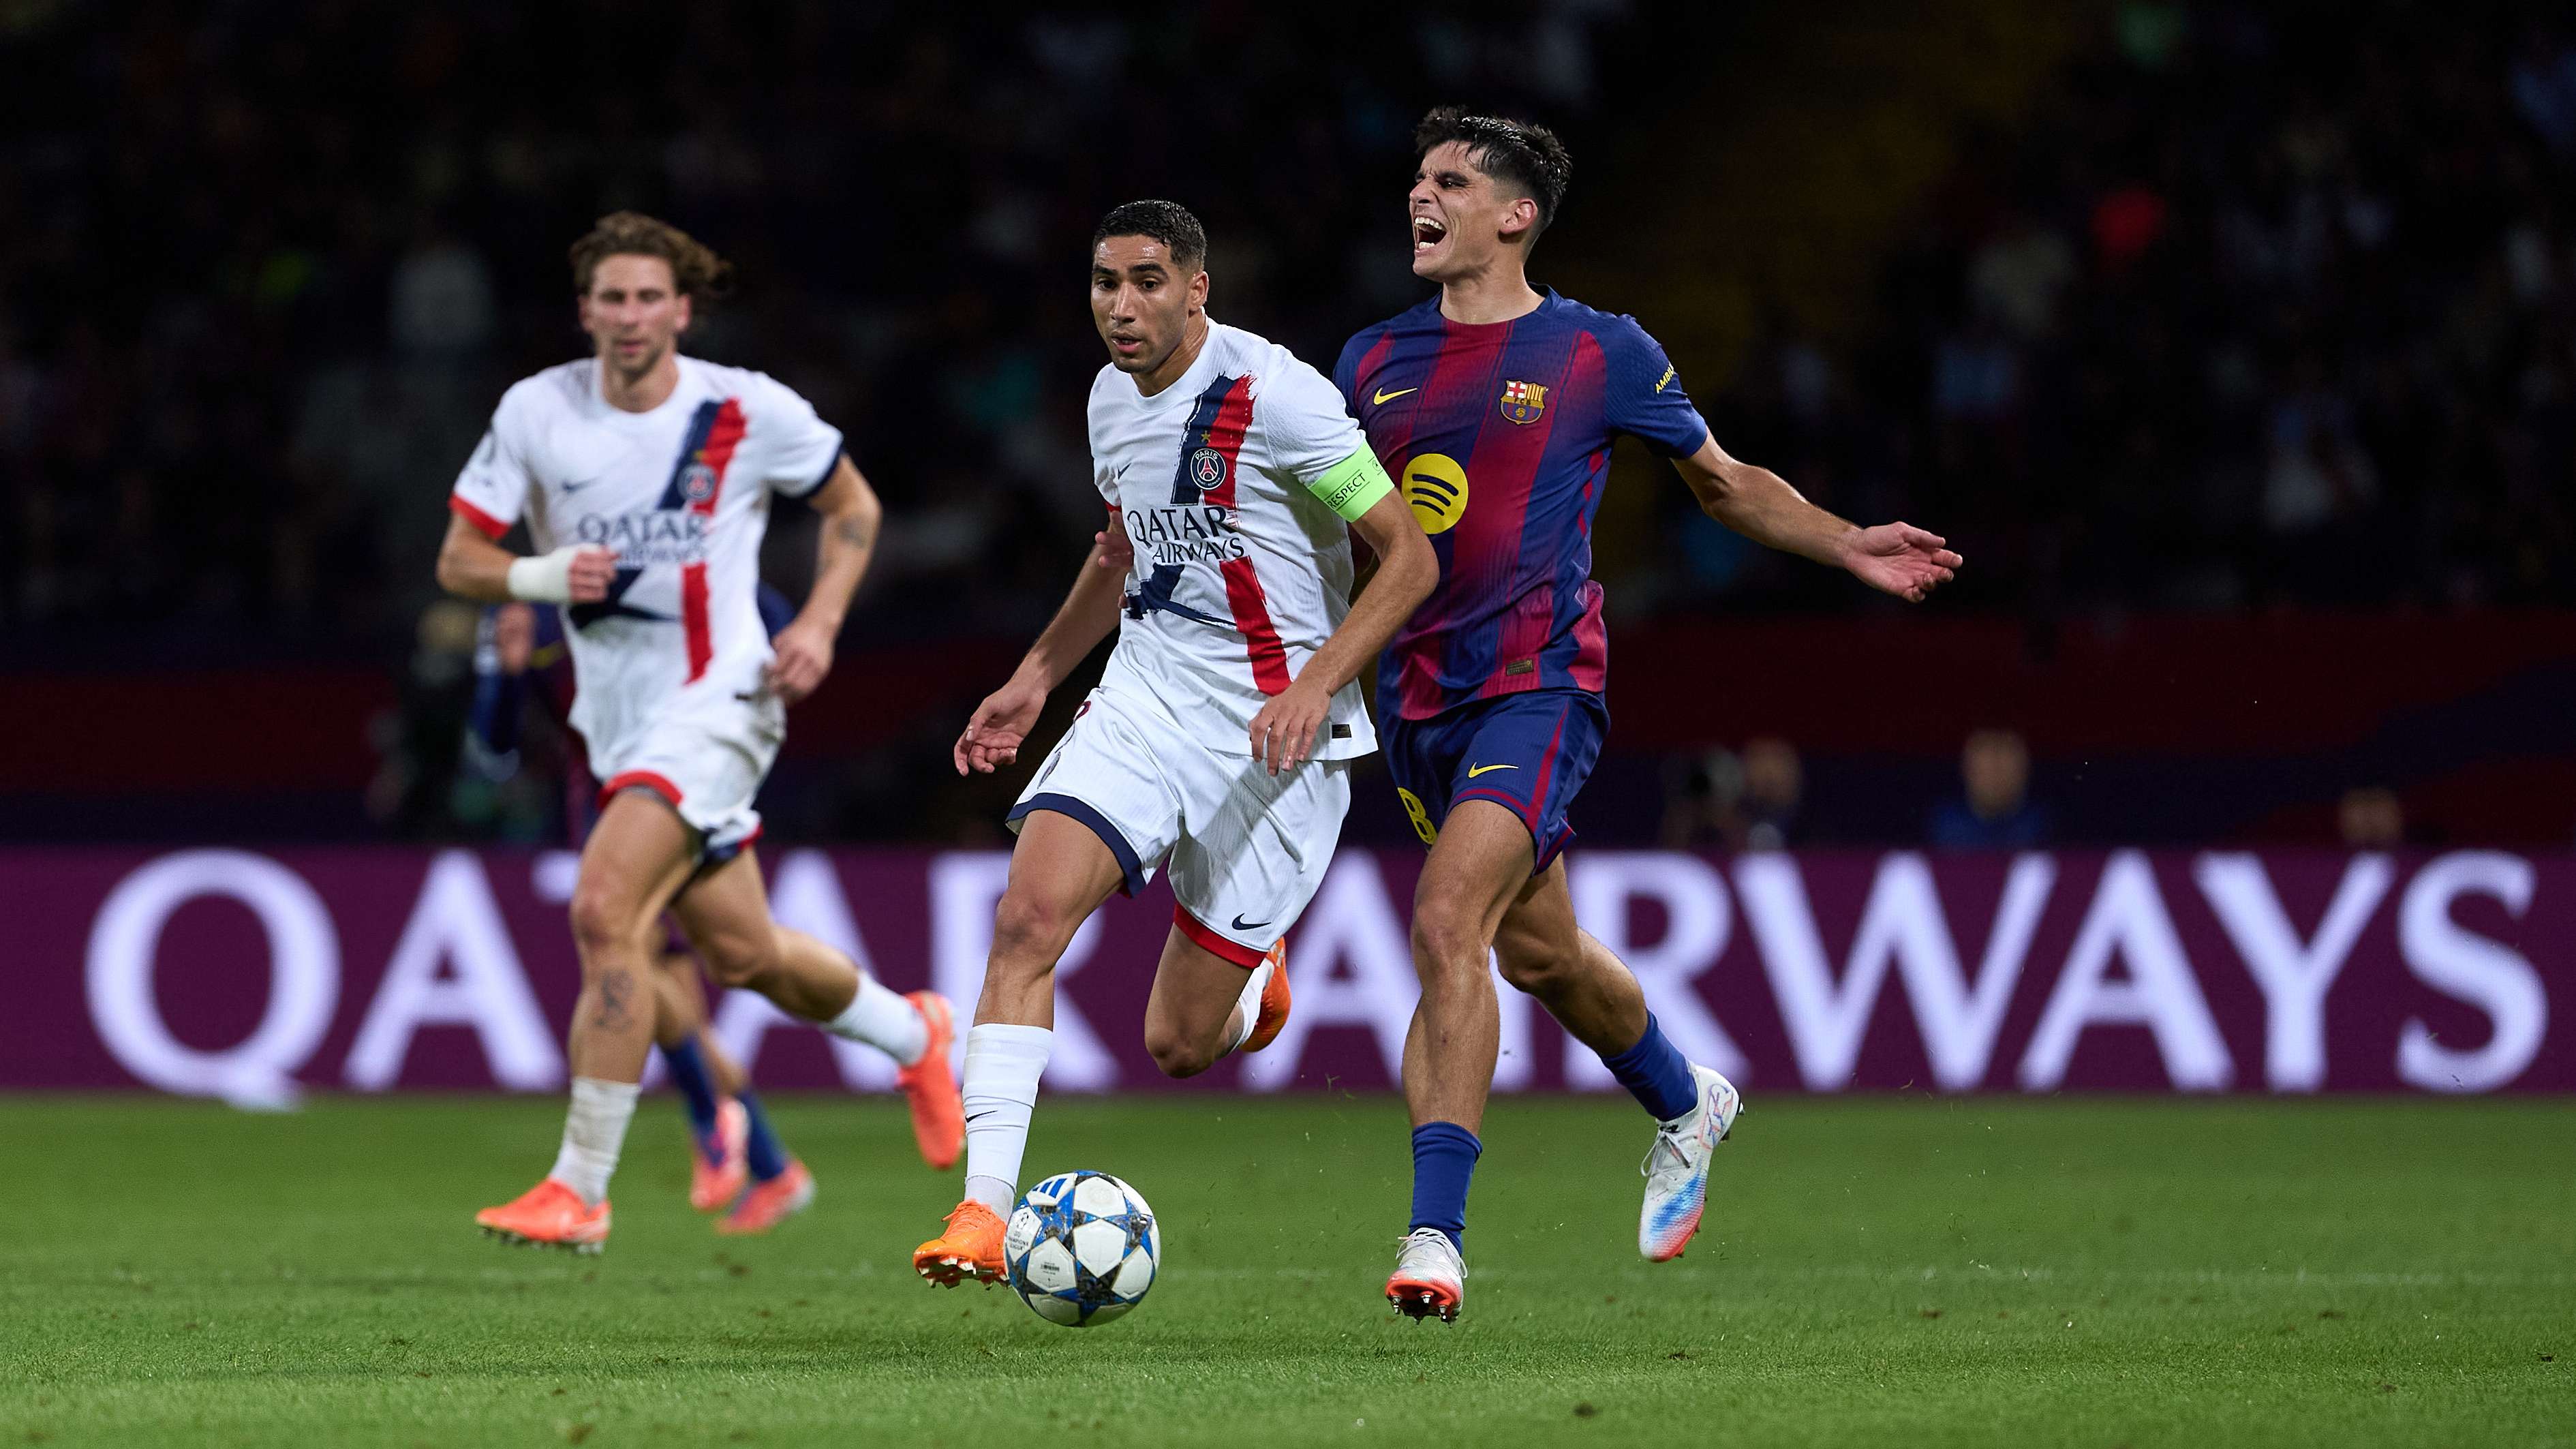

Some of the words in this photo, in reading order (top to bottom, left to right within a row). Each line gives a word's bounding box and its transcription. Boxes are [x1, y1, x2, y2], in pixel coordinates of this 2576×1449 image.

[1195, 450, 1218, 460] PARIS
[1327, 472, 1365, 508] RESPECT
[578, 512, 707, 545] QATAR
[1127, 506, 1238, 549] QATAR
[1152, 537, 1244, 563] AIRWAYS
[85, 845, 1128, 1111] QAAR
